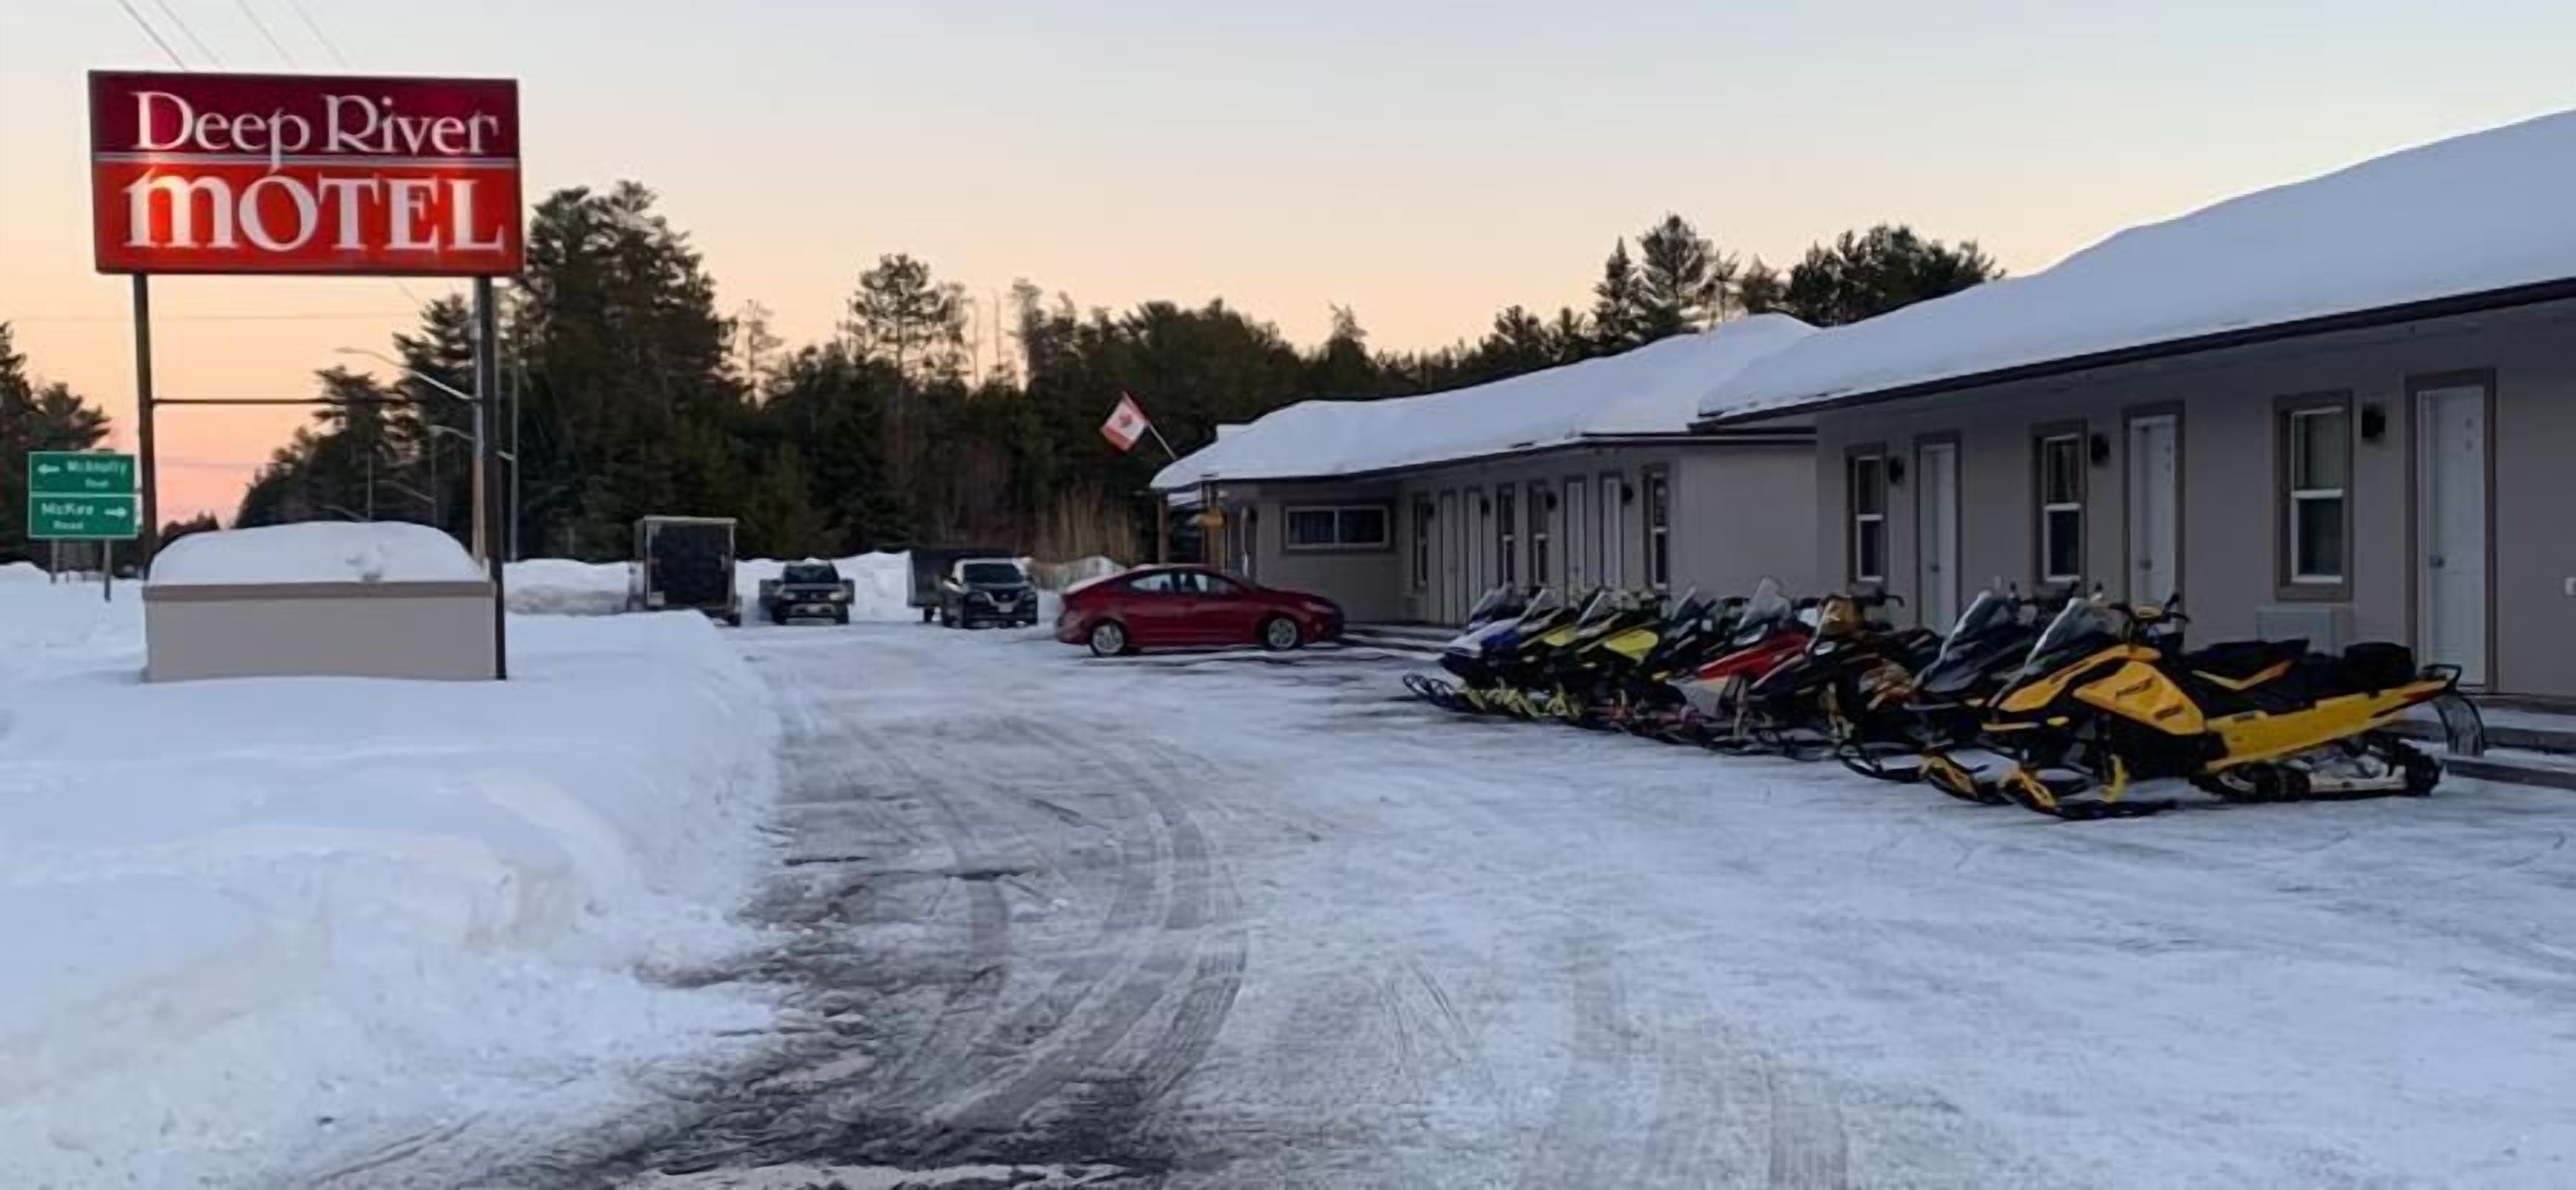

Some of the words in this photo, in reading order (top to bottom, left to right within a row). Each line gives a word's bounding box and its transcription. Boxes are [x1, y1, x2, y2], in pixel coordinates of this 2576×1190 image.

[132, 91, 310, 173] Deep
[323, 94, 500, 155] River
[122, 166, 505, 253] MOTEL
